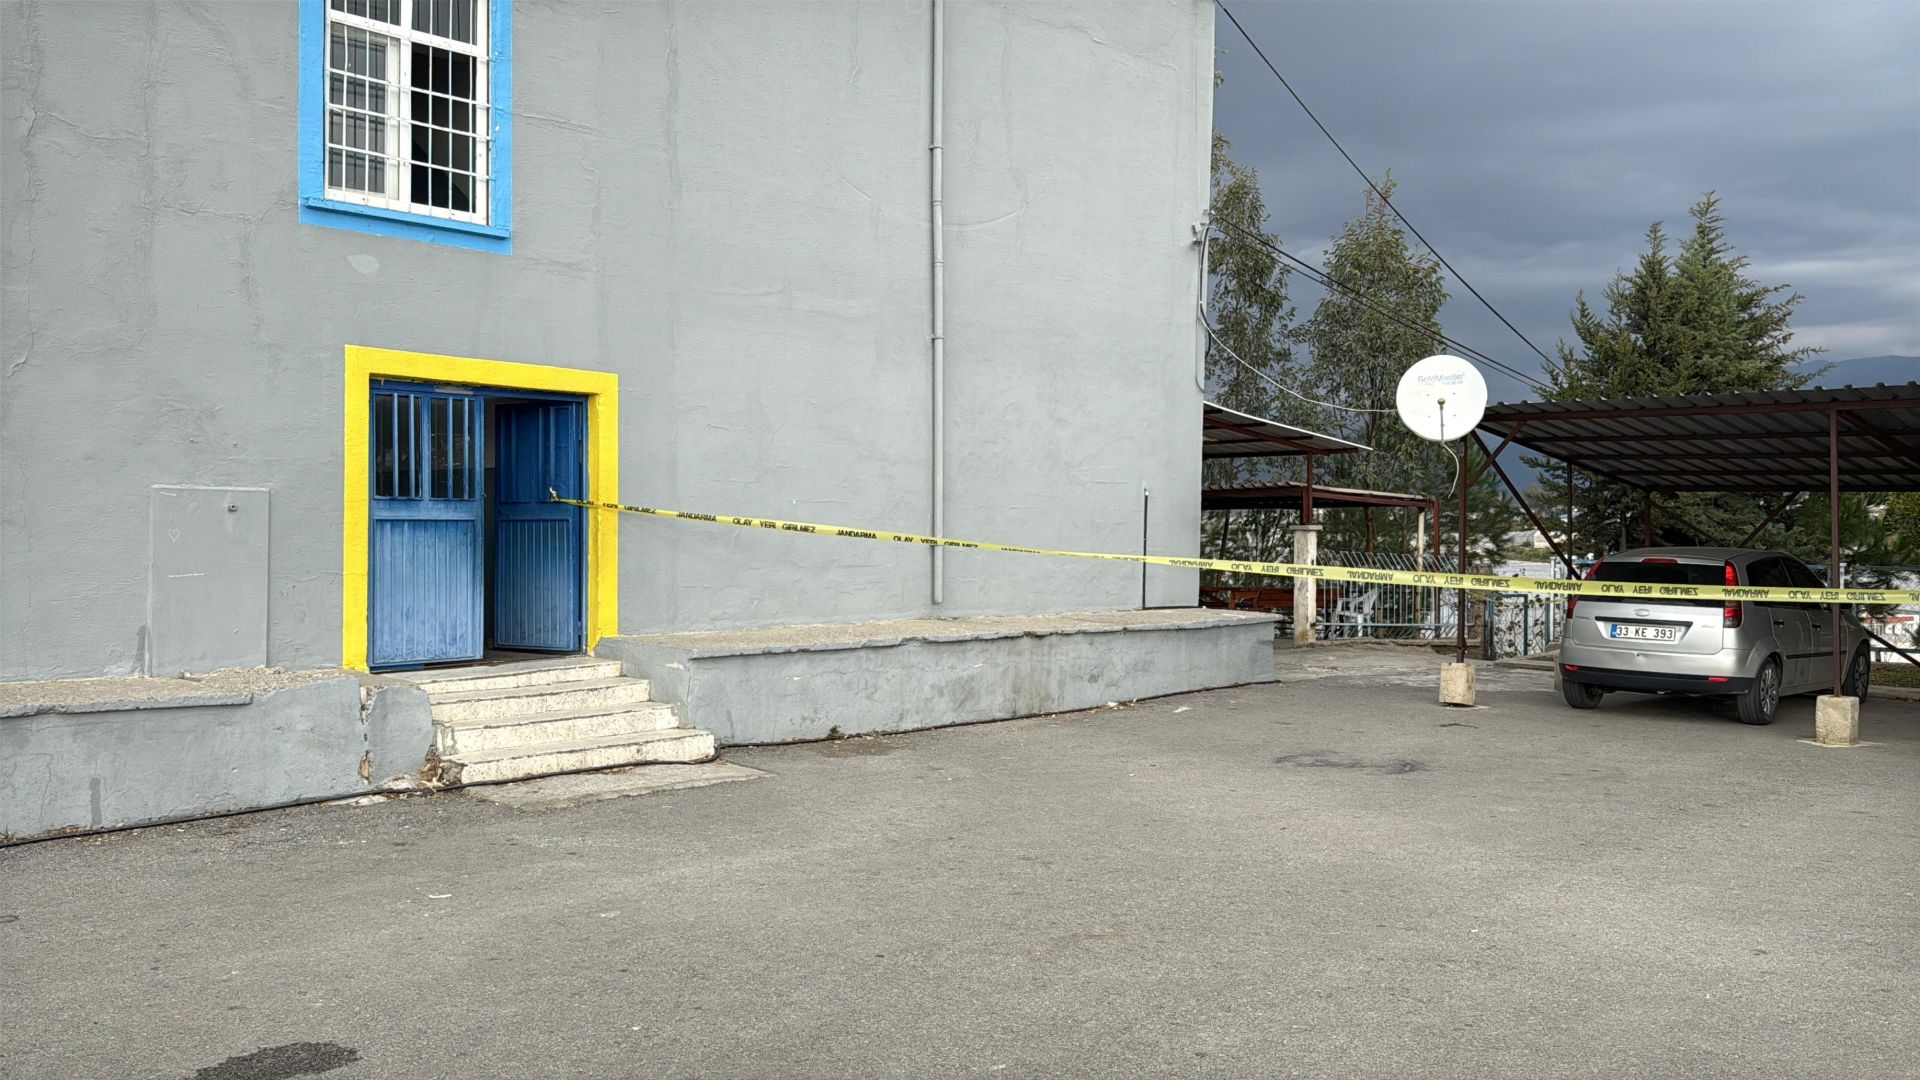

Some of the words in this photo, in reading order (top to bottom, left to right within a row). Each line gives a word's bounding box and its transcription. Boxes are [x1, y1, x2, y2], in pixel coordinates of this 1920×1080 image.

[732, 517, 753, 526] OLAY
[1616, 625, 1629, 637] 33
[1634, 627, 1647, 638] KE
[1653, 629, 1673, 639] 393
